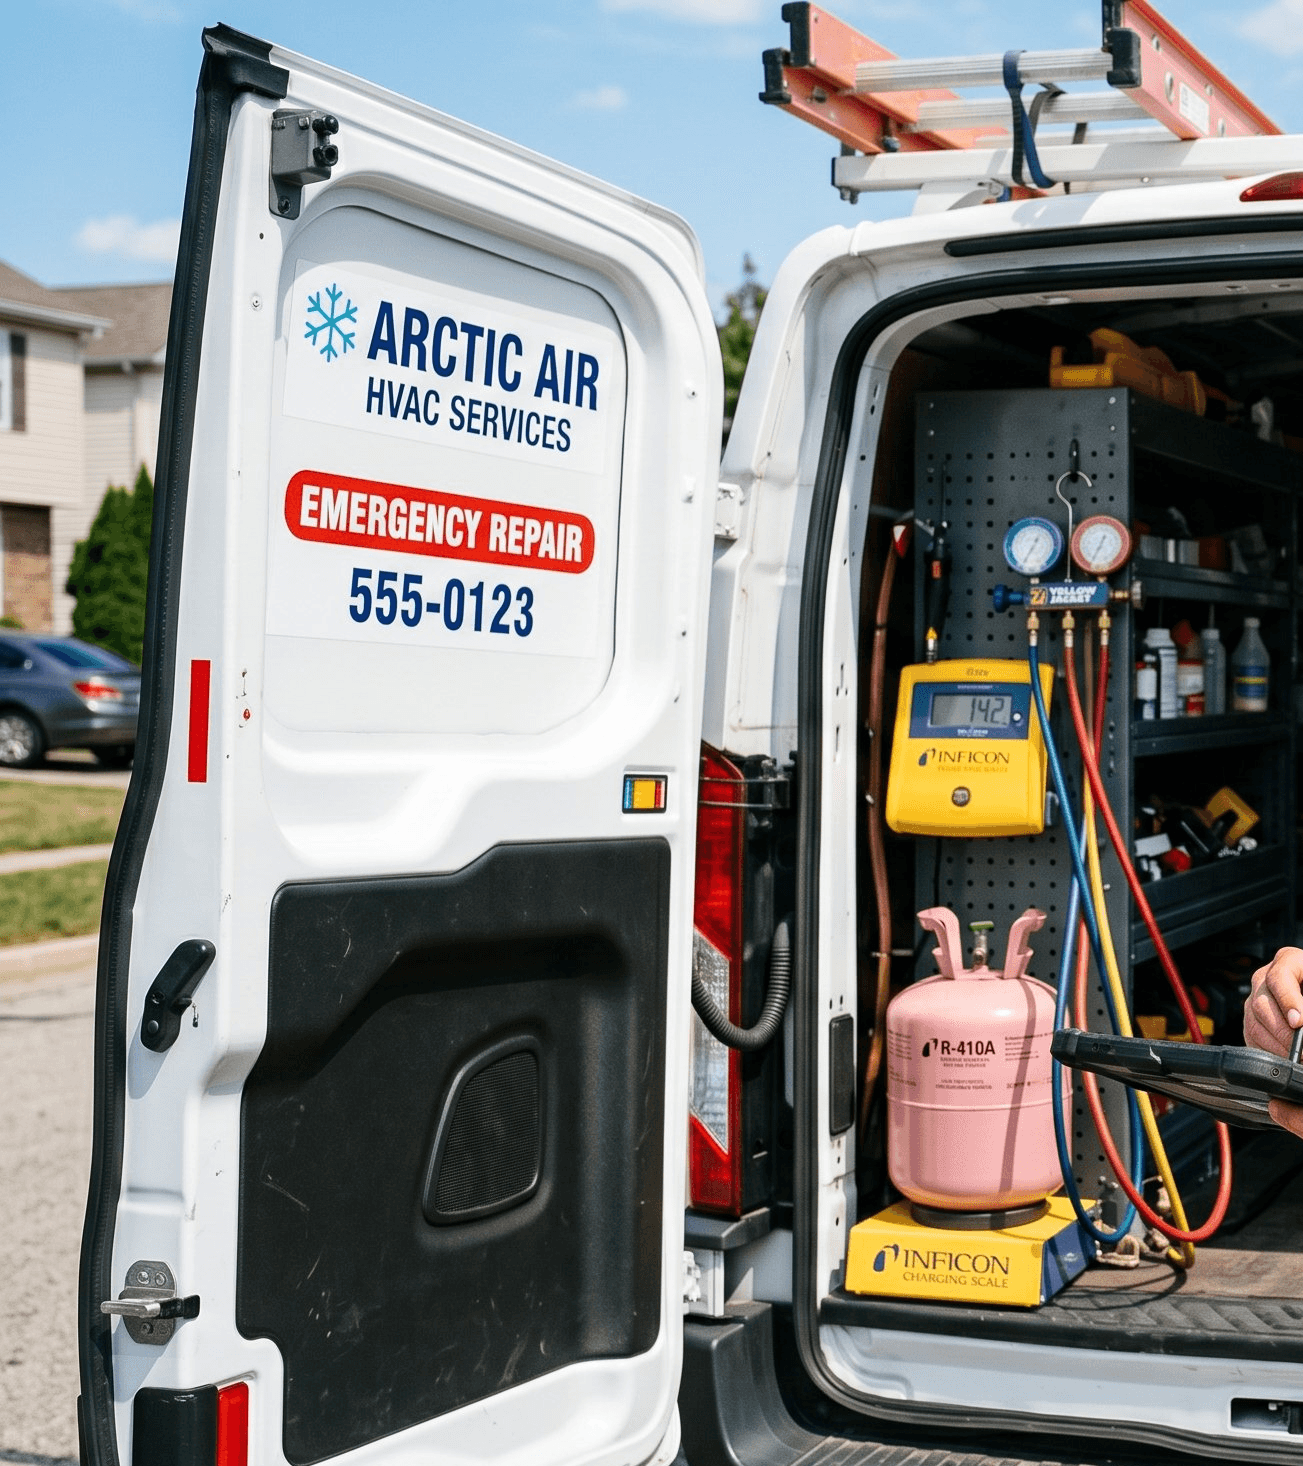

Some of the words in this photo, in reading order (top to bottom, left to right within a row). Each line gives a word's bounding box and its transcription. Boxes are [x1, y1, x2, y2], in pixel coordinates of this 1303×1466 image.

[366, 300, 524, 393] ARCTIC
[534, 343, 600, 411] AIR
[366, 376, 440, 426] HVAC
[449, 395, 572, 453] SERVICES
[299, 484, 483, 549] EMERGENCY
[488, 512, 583, 563] REPAIR
[348, 566, 535, 637] 555-0123
[1048, 585, 1097, 596] YELLOW
[938, 750, 1010, 765] INFICON
[940, 1040, 996, 1056] R-410A
[903, 1248, 1010, 1276] INFICON
[902, 1270, 968, 1286] CHARGING
[971, 1275, 1009, 1289] SCALE
